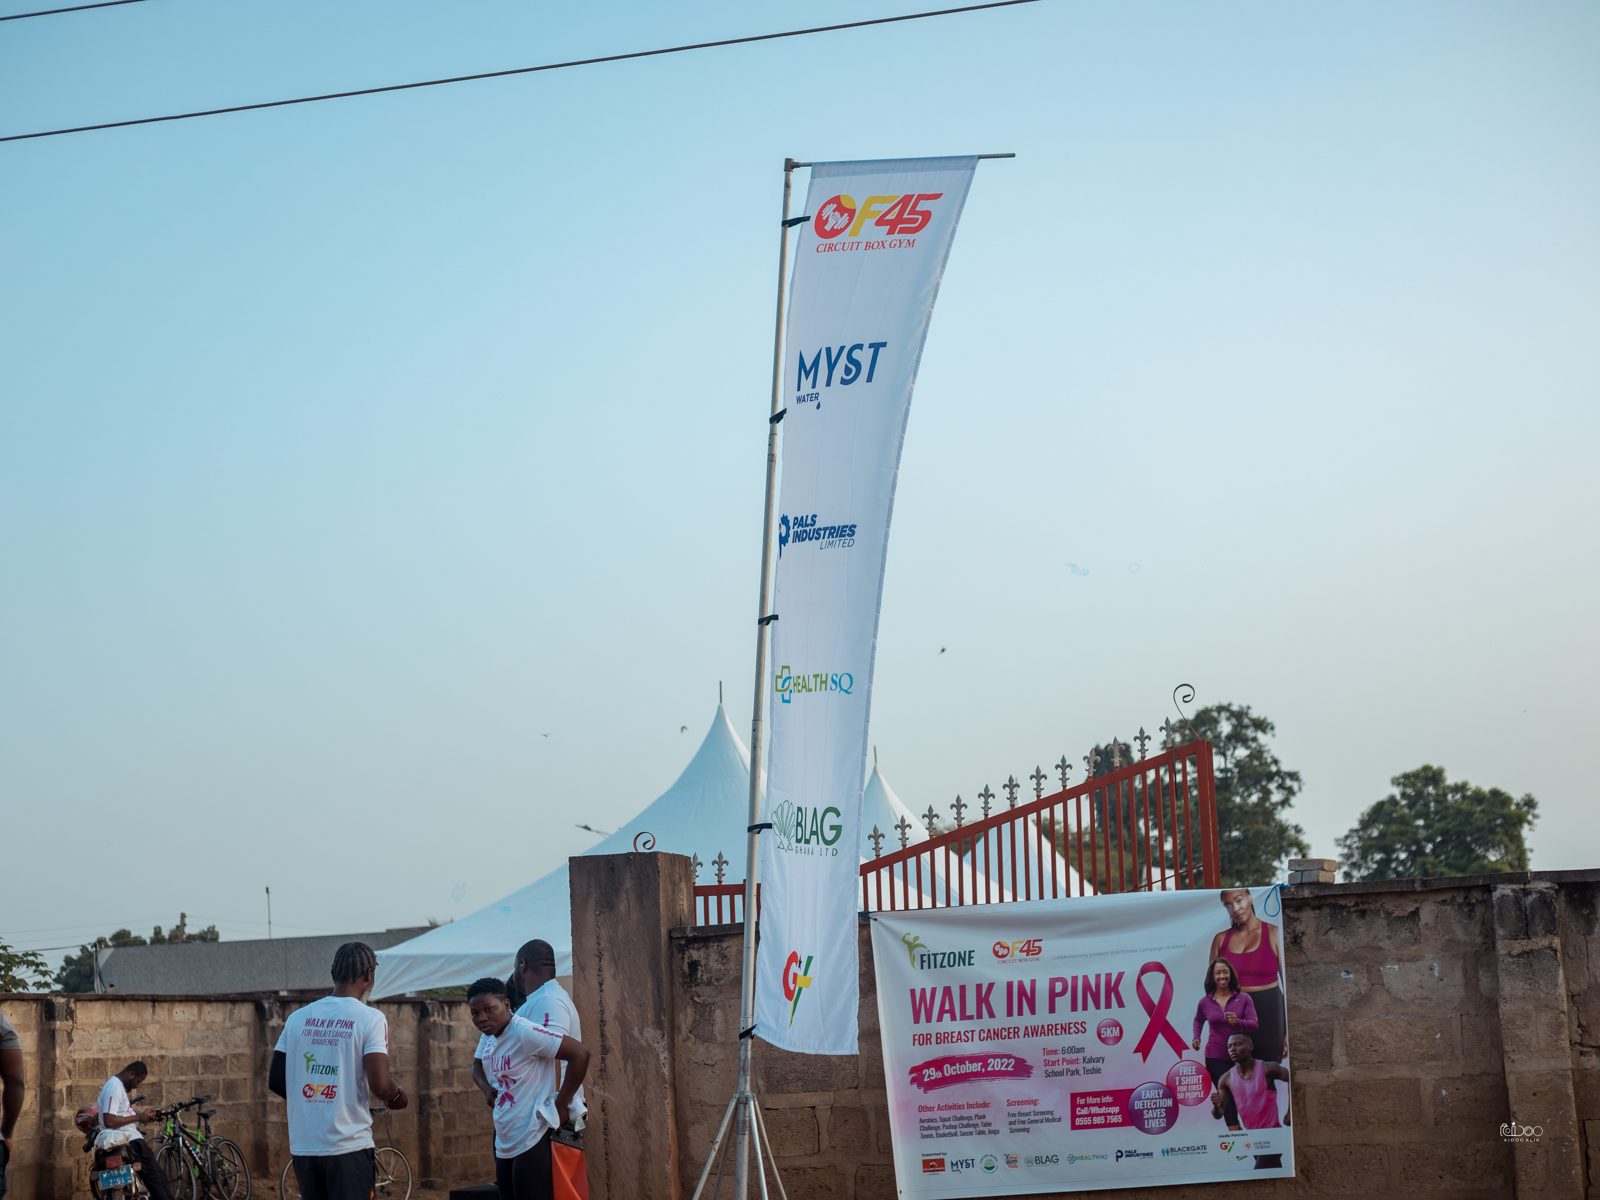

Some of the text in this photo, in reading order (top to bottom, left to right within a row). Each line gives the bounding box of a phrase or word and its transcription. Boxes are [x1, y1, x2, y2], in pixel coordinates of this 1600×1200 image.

[816, 238, 917, 253] CIRCUIT BOX GYM
[796, 341, 888, 392] MYST
[796, 392, 820, 405] WATER
[792, 513, 818, 529] PALS
[791, 523, 858, 544] INDUSTRIES
[819, 538, 855, 550] LIMITED
[795, 806, 843, 847] BLAG
[820, 848, 839, 857] LTD
[920, 949, 976, 970] FITZONE
[910, 971, 1126, 1024] WALK IN PINK
[304, 1018, 327, 1028] WALK
[335, 1019, 356, 1030] PINK
[912, 1021, 1087, 1047] FOR BREAST CANCER AWARENESS
[1100, 1025, 1120, 1038] 5KM
[1042, 1046, 1085, 1056] Time: 6:00am
[1043, 1055, 1105, 1067] Start Point: Kalvary
[922, 1058, 1015, 1082] 29th October, 2022
[1044, 1066, 1102, 1078] School Park, Teshie
[1179, 1066, 1197, 1076] FREE
[1181, 1075, 1203, 1085] SHIRT
[1076, 1097, 1086, 1105] For
[1086, 1096, 1101, 1104] More
[1141, 1089, 1164, 1100] EARLY
[917, 1101, 991, 1113] Other Activities Include:
[1134, 1098, 1173, 1110] DETECTION
[1143, 1108, 1166, 1119] SAVES
[1144, 1118, 1167, 1129] LIVES!
[950, 1158, 976, 1169] MYST
[1034, 1154, 1060, 1165] BLAG
